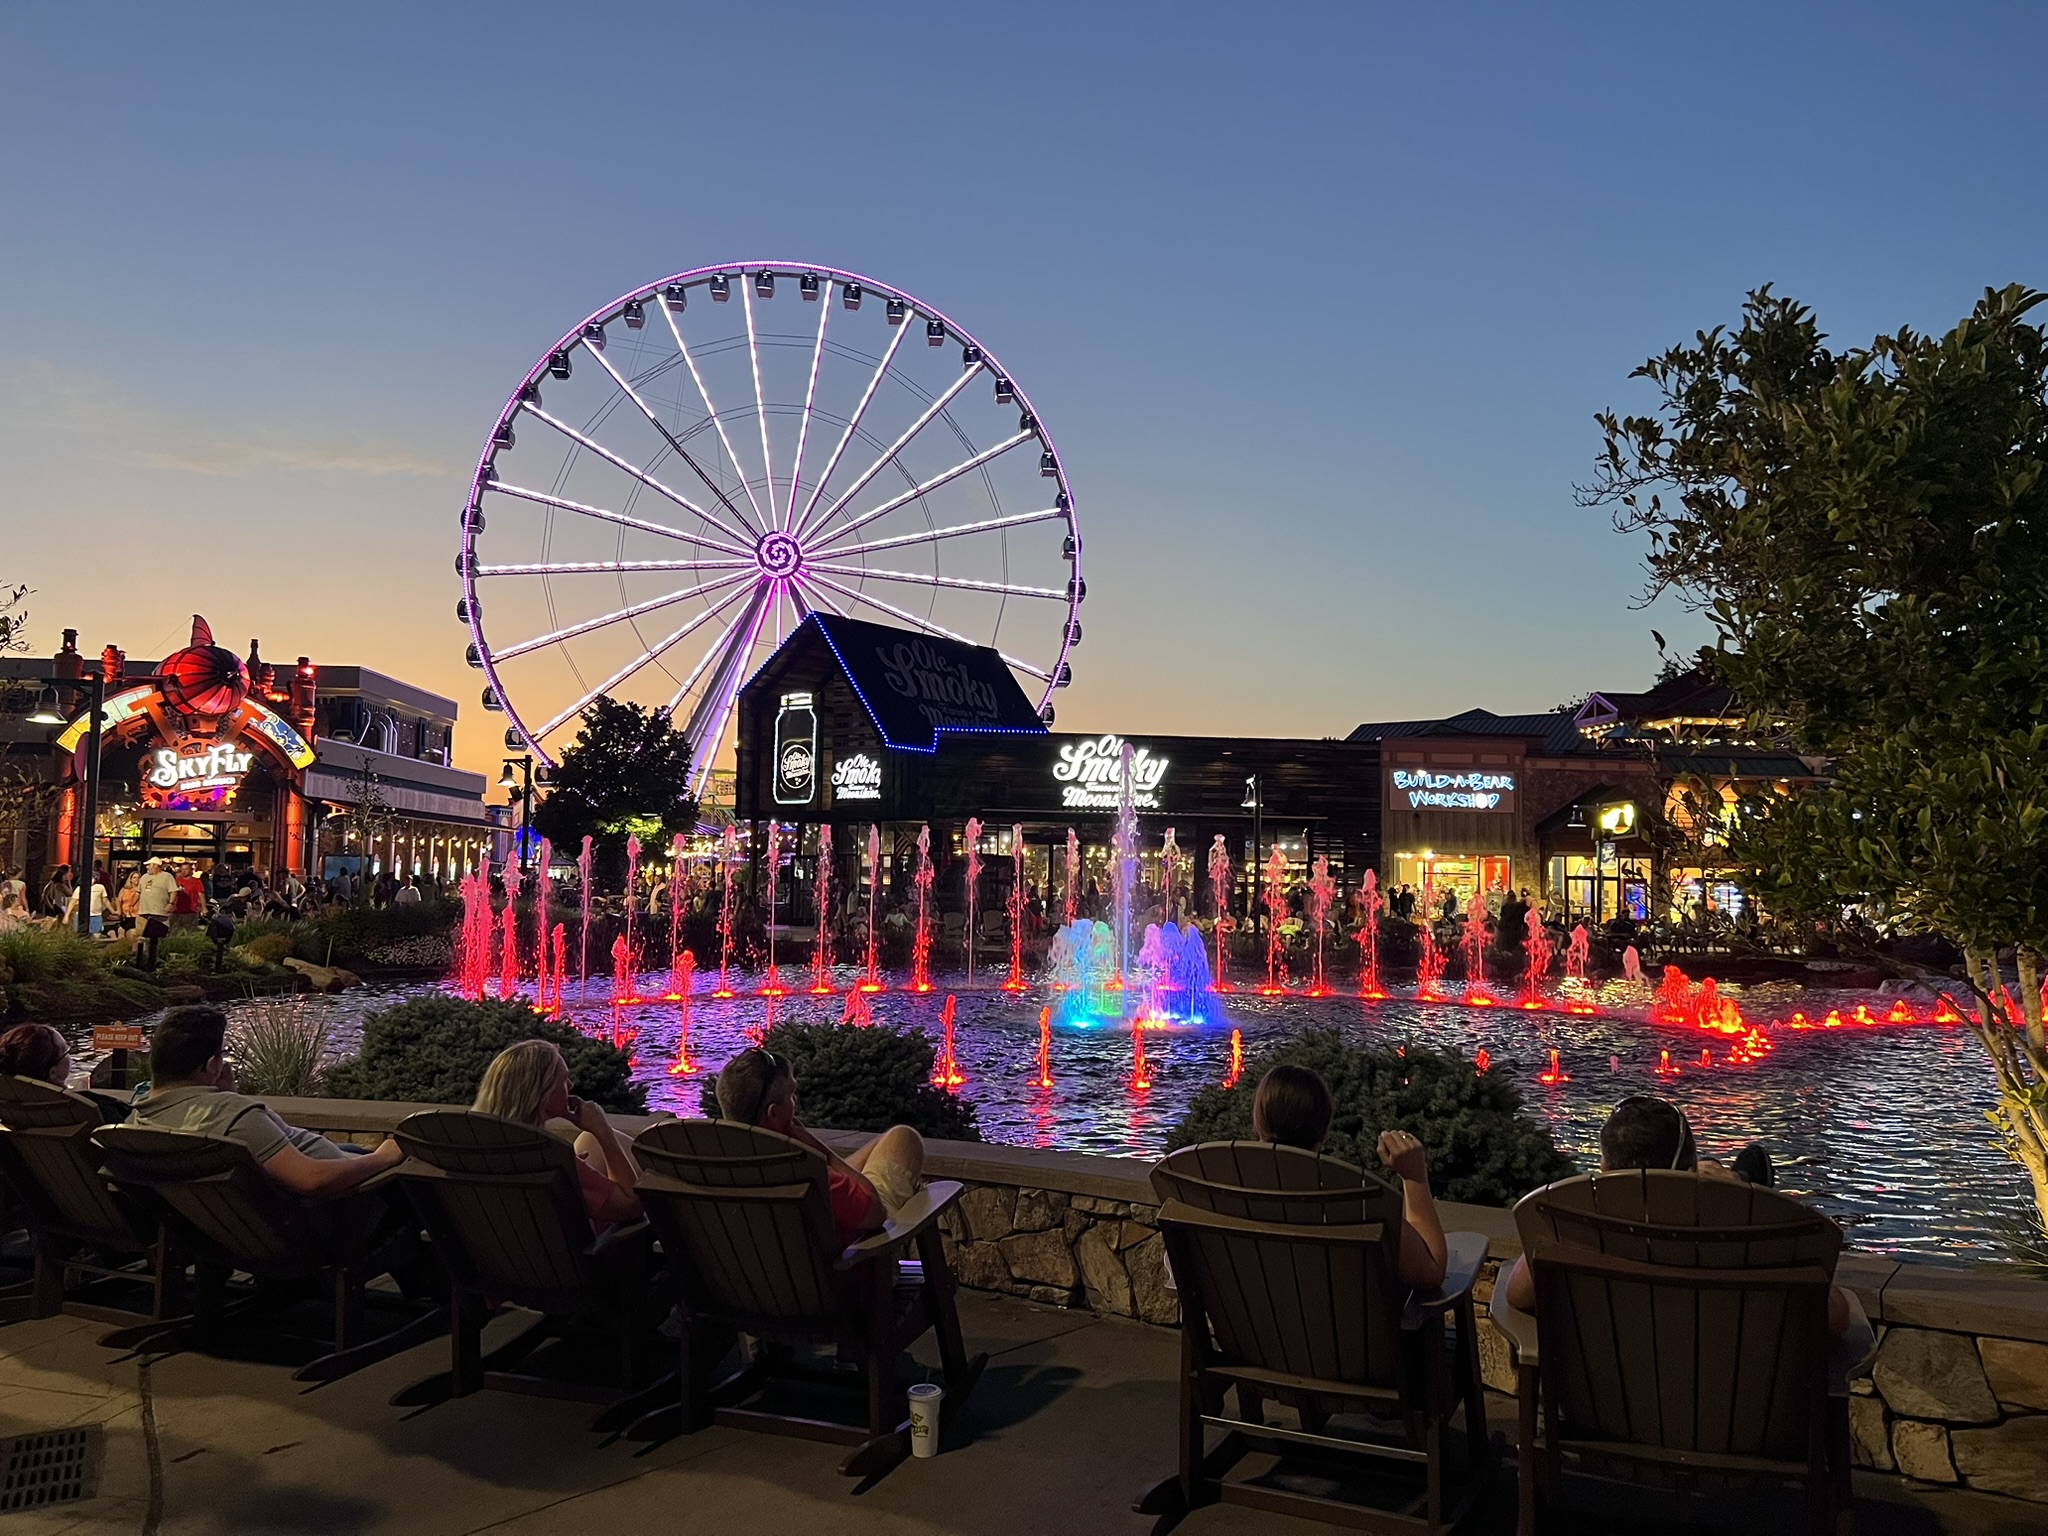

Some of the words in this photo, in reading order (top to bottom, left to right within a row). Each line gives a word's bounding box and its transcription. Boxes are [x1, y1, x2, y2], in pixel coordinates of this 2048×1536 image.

[910, 638, 960, 677] Ole
[874, 642, 998, 719] Smoky
[781, 754, 810, 771] Smoky
[854, 754, 871, 768] Ole
[836, 787, 881, 799] Moonshine
[1408, 790, 1500, 809] WORKSHOP
[96, 1033, 114, 1041] PLEASE
[128, 1034, 139, 1042] OUT
